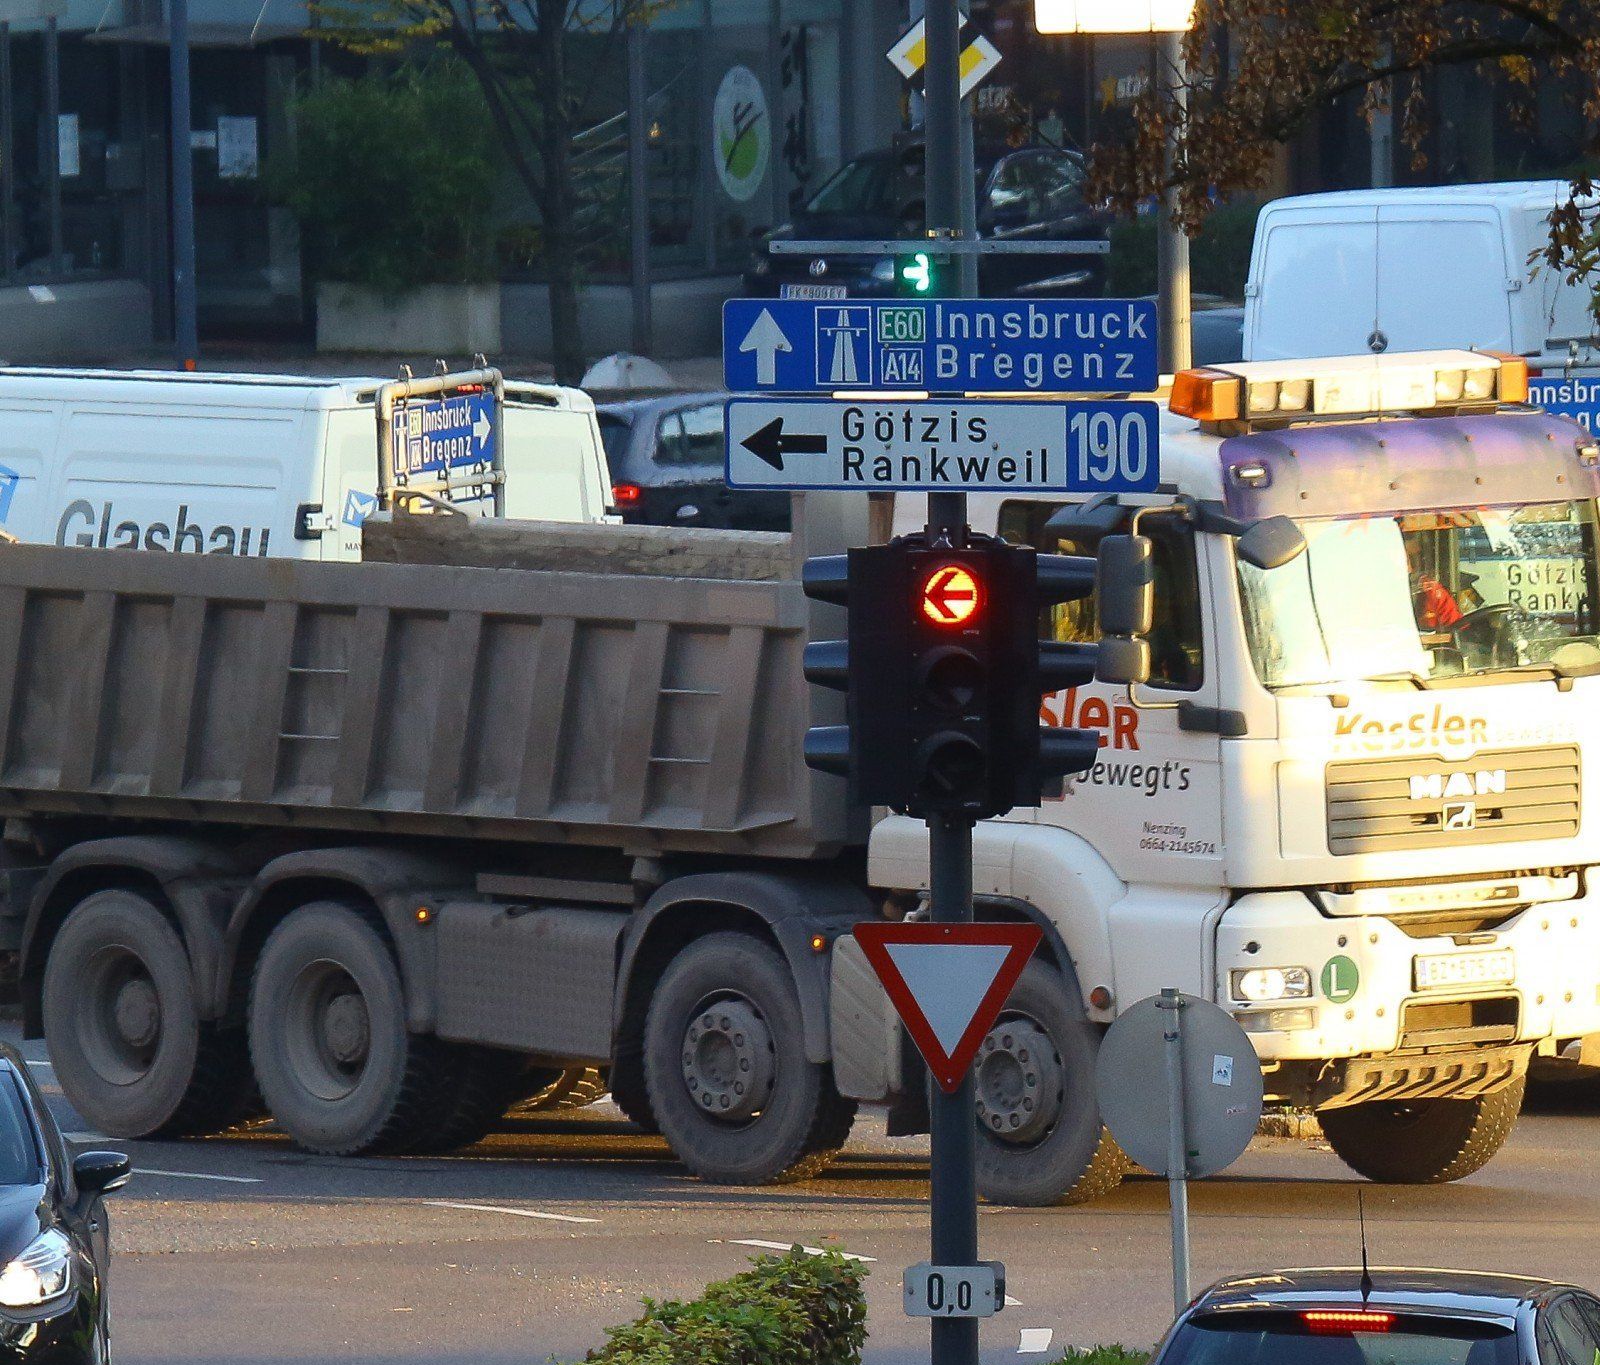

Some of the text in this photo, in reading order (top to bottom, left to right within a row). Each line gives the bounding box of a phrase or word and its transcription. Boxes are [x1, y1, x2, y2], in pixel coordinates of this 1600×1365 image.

[880, 309, 921, 340] E60
[936, 304, 1147, 339] Innsbruck
[884, 352, 920, 382] A14
[936, 344, 1134, 386] Bregenz
[422, 399, 472, 433] Innsbruck
[842, 407, 988, 442] Götzis
[422, 435, 472, 468] Bregenz
[1070, 412, 1148, 482] 190
[842, 447, 1048, 483] Rankweil
[1410, 769, 1506, 799] MAN
[1142, 822, 1187, 838] Nenzing
[1330, 964, 1350, 997] L
[927, 1273, 971, 1314] 0,0
